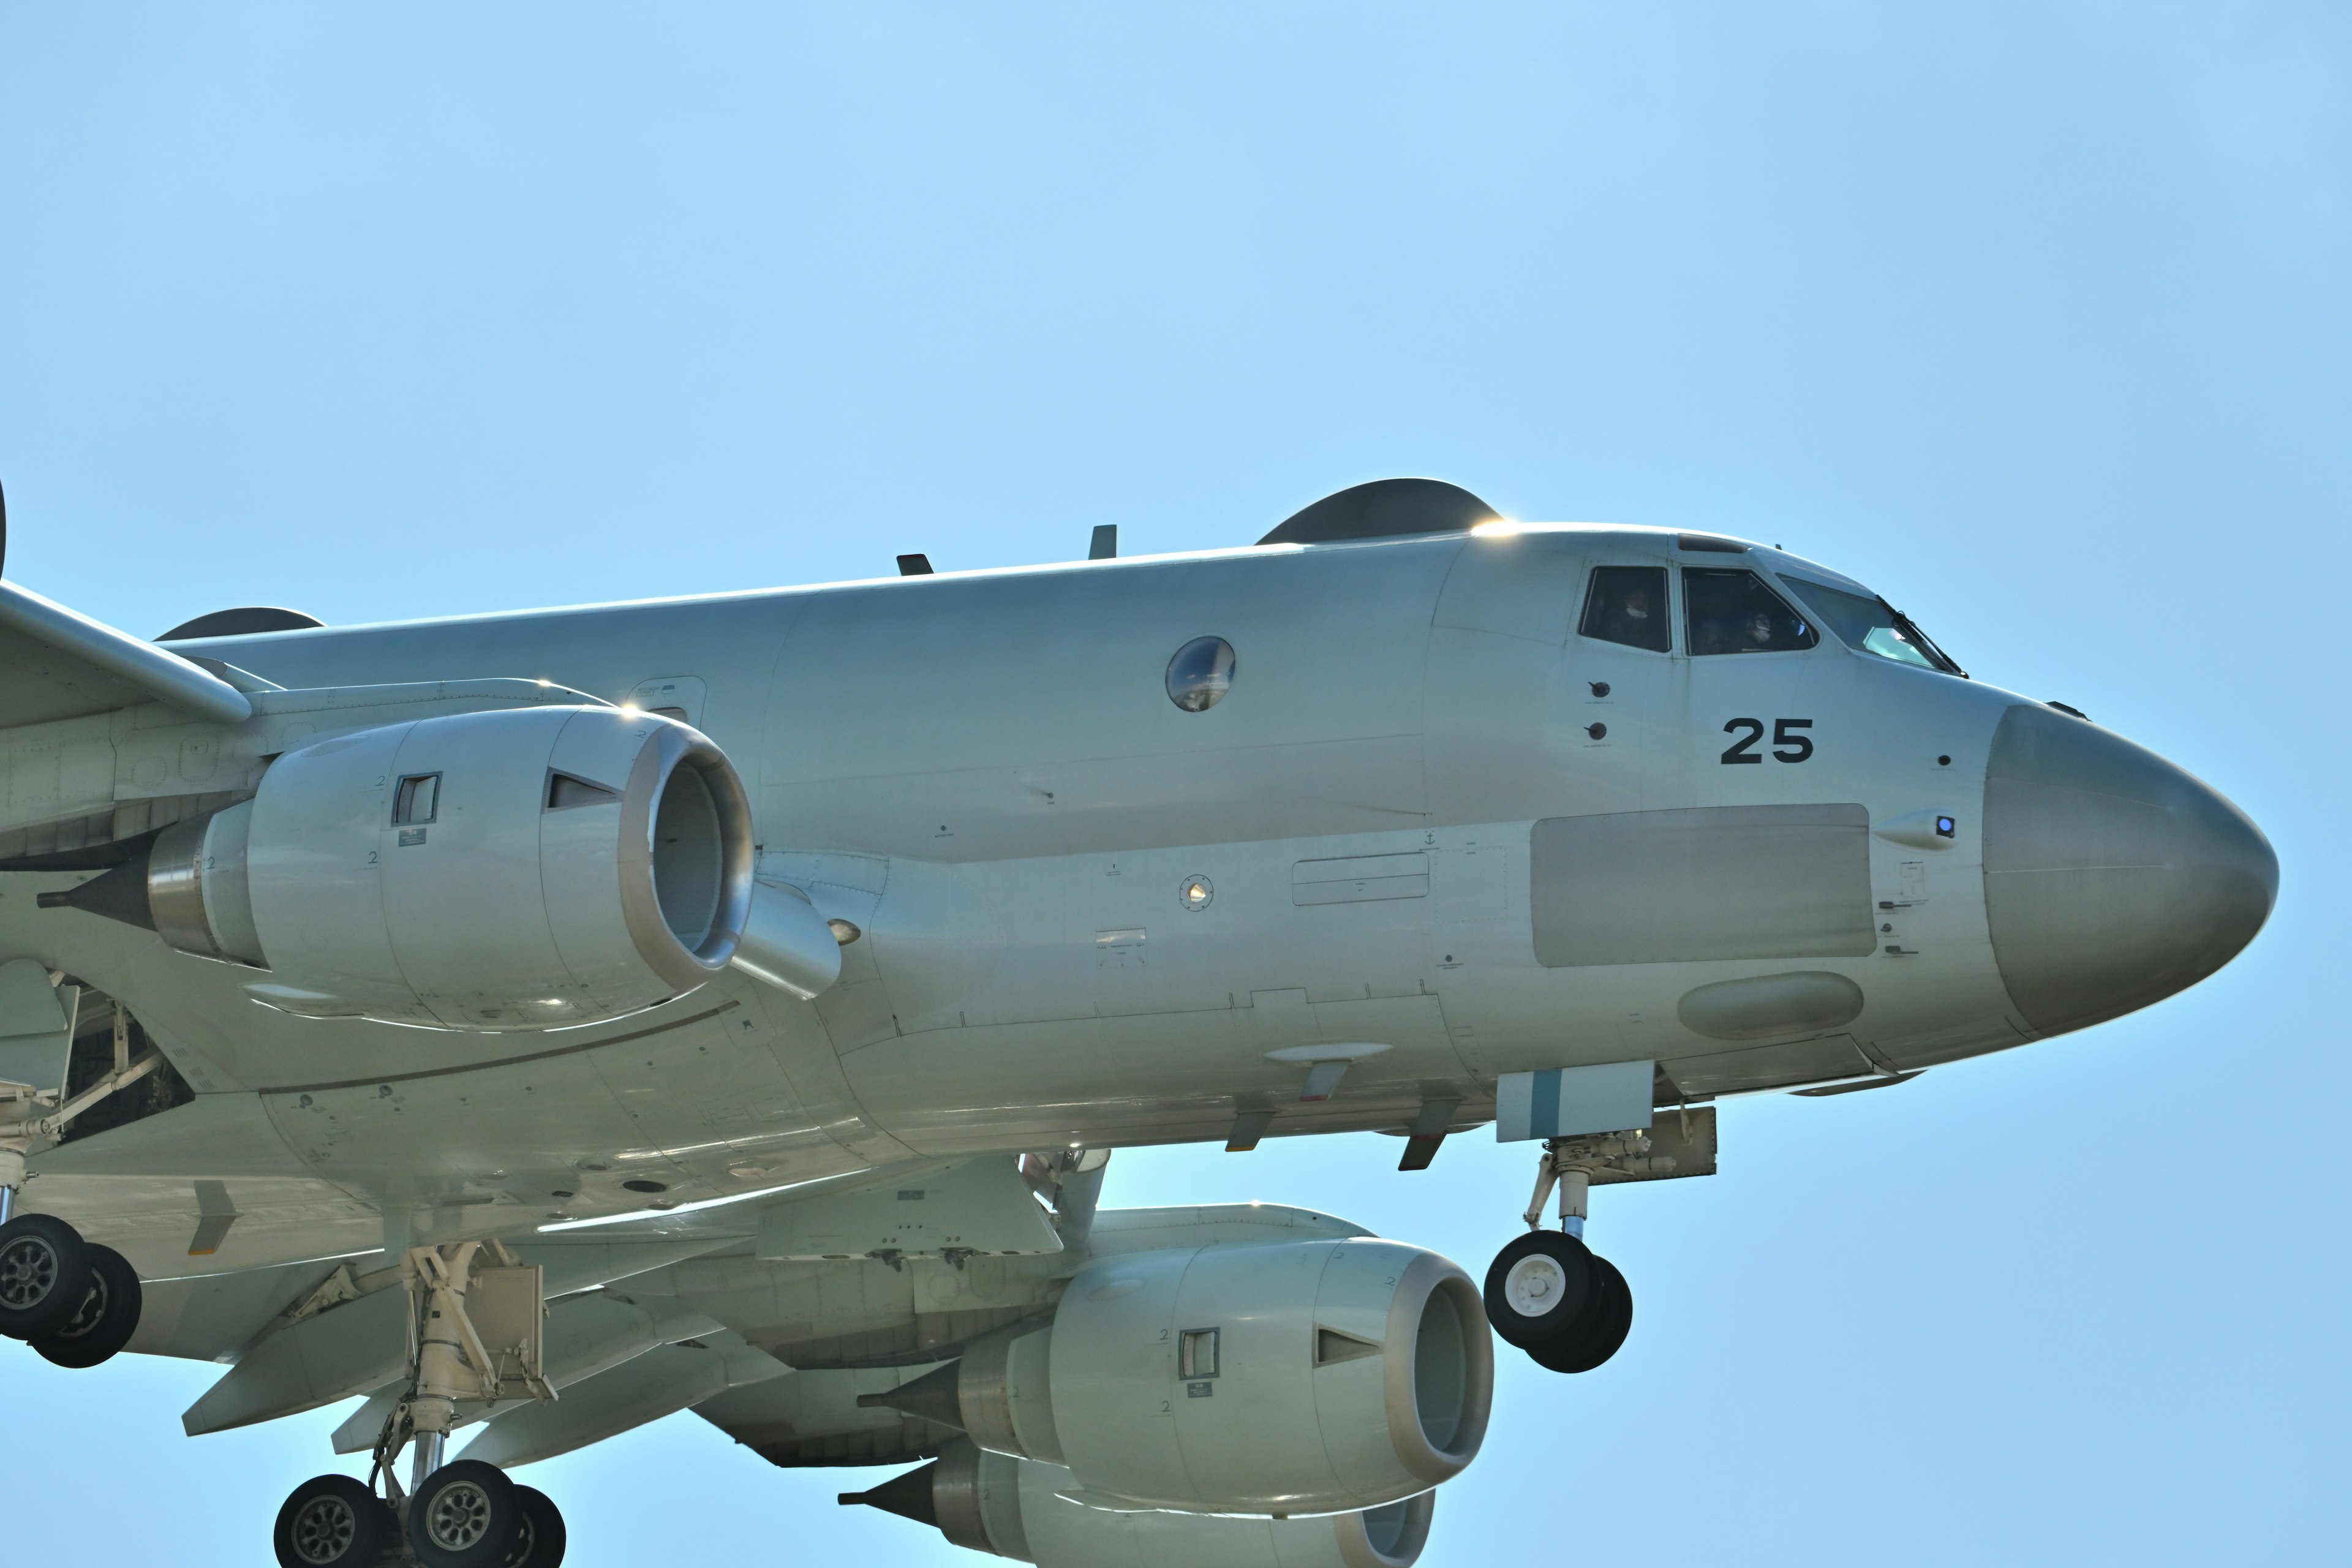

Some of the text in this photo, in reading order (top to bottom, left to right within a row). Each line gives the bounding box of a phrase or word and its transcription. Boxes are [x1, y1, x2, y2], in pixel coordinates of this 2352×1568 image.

[1721, 717, 1814, 765] 25
[374, 775, 386, 787] 2
[206, 856, 216, 870] 2
[368, 851, 379, 864] 2
[1384, 1276, 1396, 1286] 2
[1159, 1329, 1169, 1340] 2
[1161, 1400, 1171, 1412] 2
